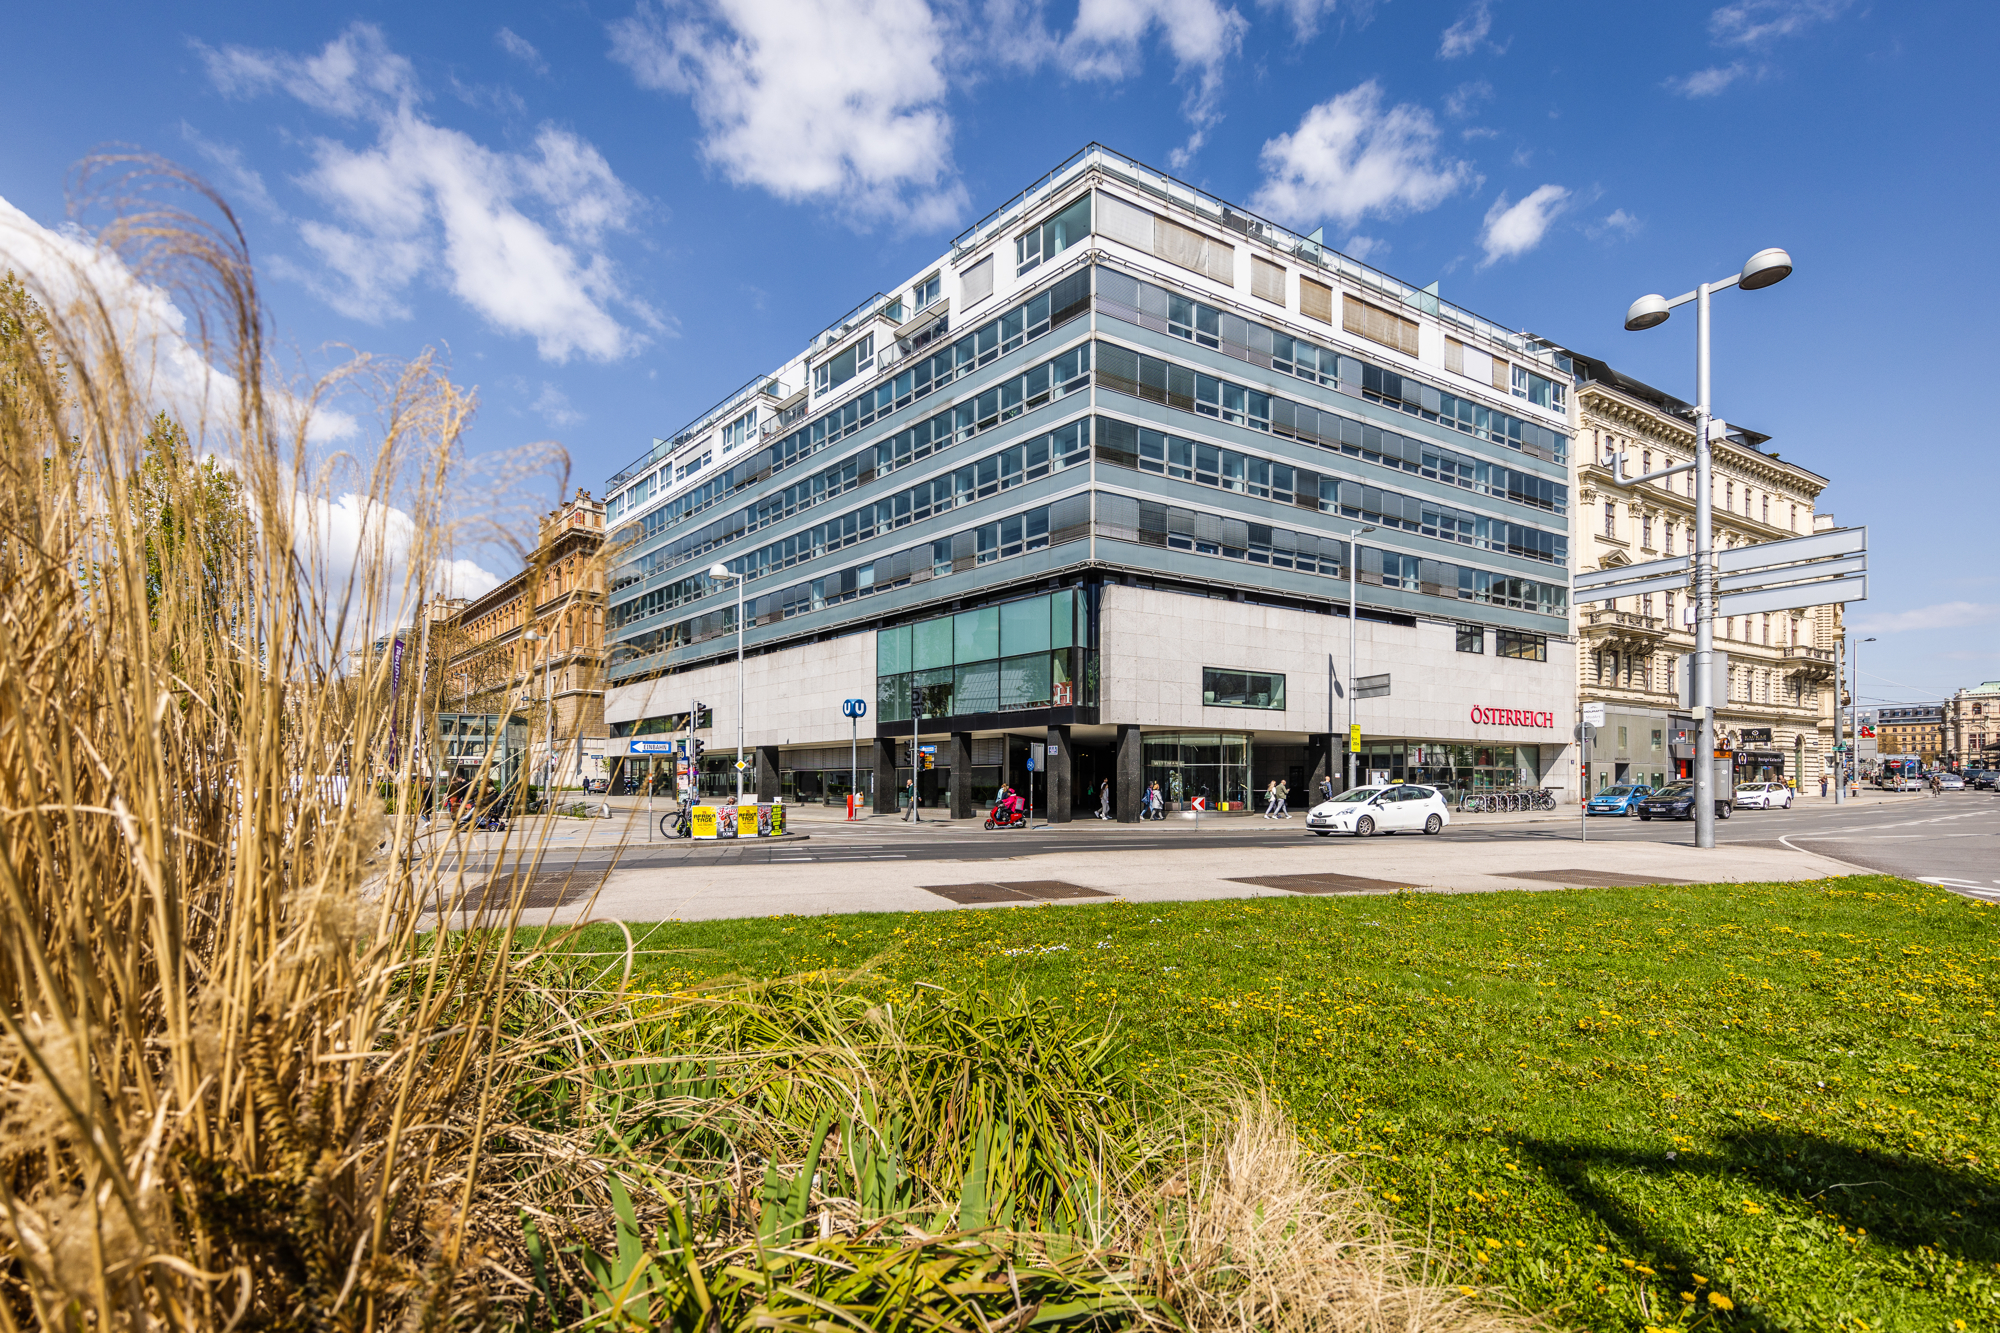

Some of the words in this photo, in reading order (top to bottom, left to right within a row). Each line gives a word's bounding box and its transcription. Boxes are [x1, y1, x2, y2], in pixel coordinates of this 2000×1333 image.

[844, 702, 851, 715] U
[855, 702, 865, 715] U
[1470, 704, 1554, 729] ÖSTERREICH
